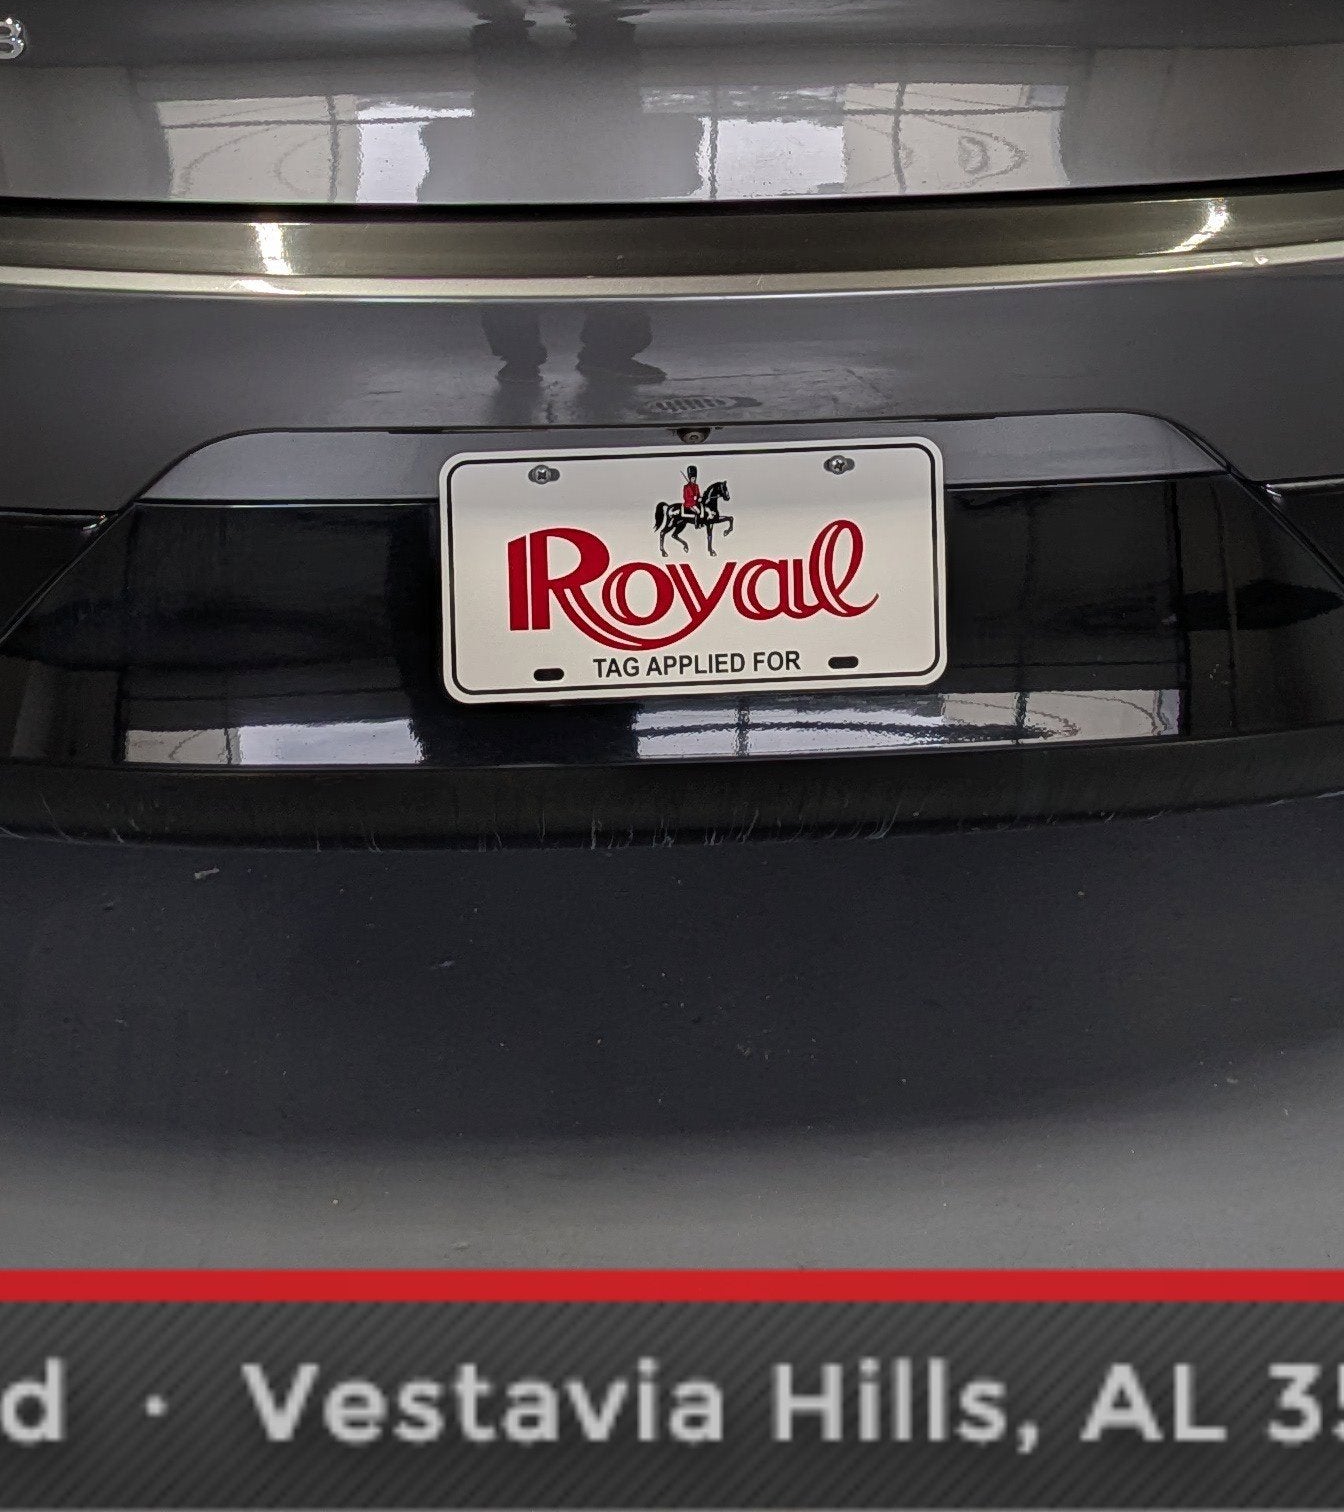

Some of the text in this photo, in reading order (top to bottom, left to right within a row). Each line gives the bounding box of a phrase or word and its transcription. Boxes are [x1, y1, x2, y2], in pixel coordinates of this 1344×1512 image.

[507, 519, 879, 652] Royal
[593, 650, 801, 679] TAG APPLIED FOR
